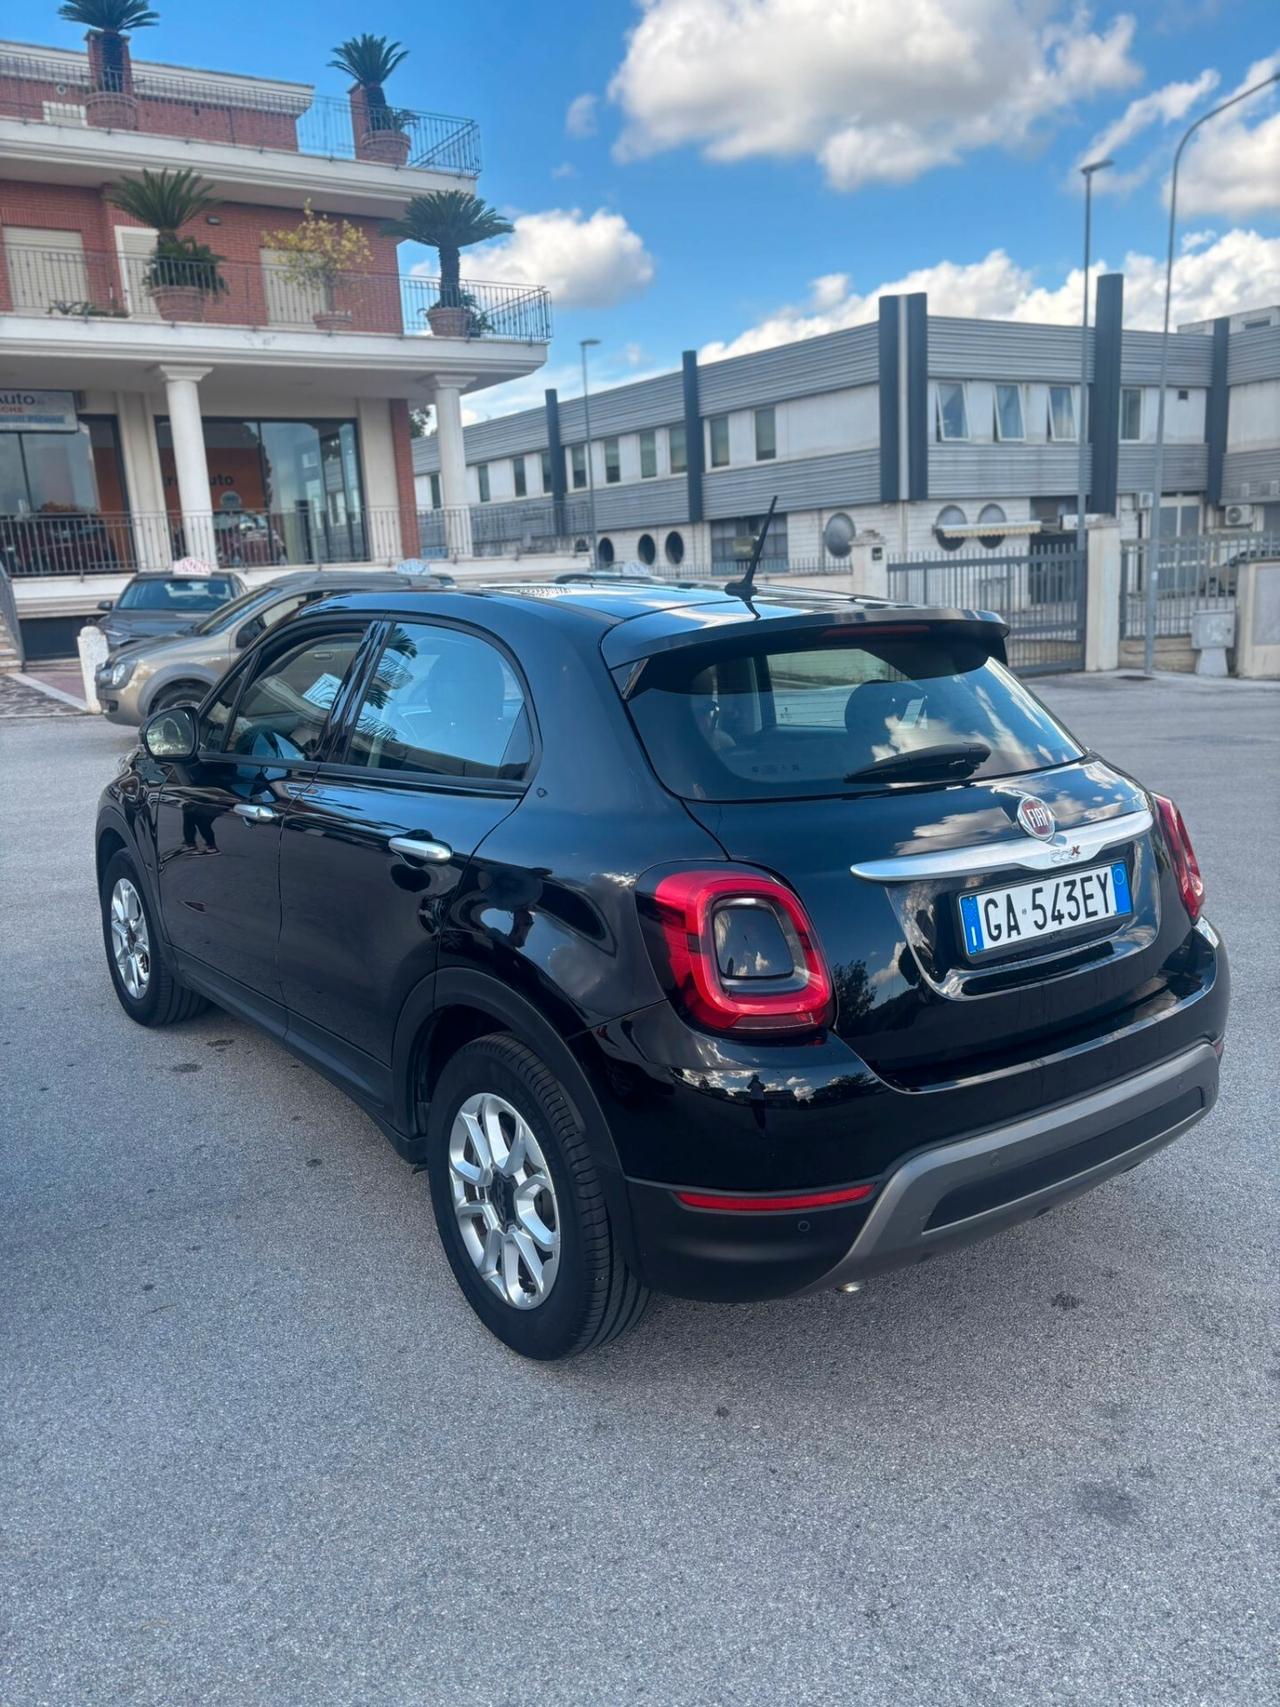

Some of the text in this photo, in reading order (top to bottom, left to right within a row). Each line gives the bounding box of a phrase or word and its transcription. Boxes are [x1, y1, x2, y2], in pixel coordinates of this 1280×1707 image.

[1026, 807, 1049, 828] FIAT
[984, 872, 1110, 942] GA 543EY
